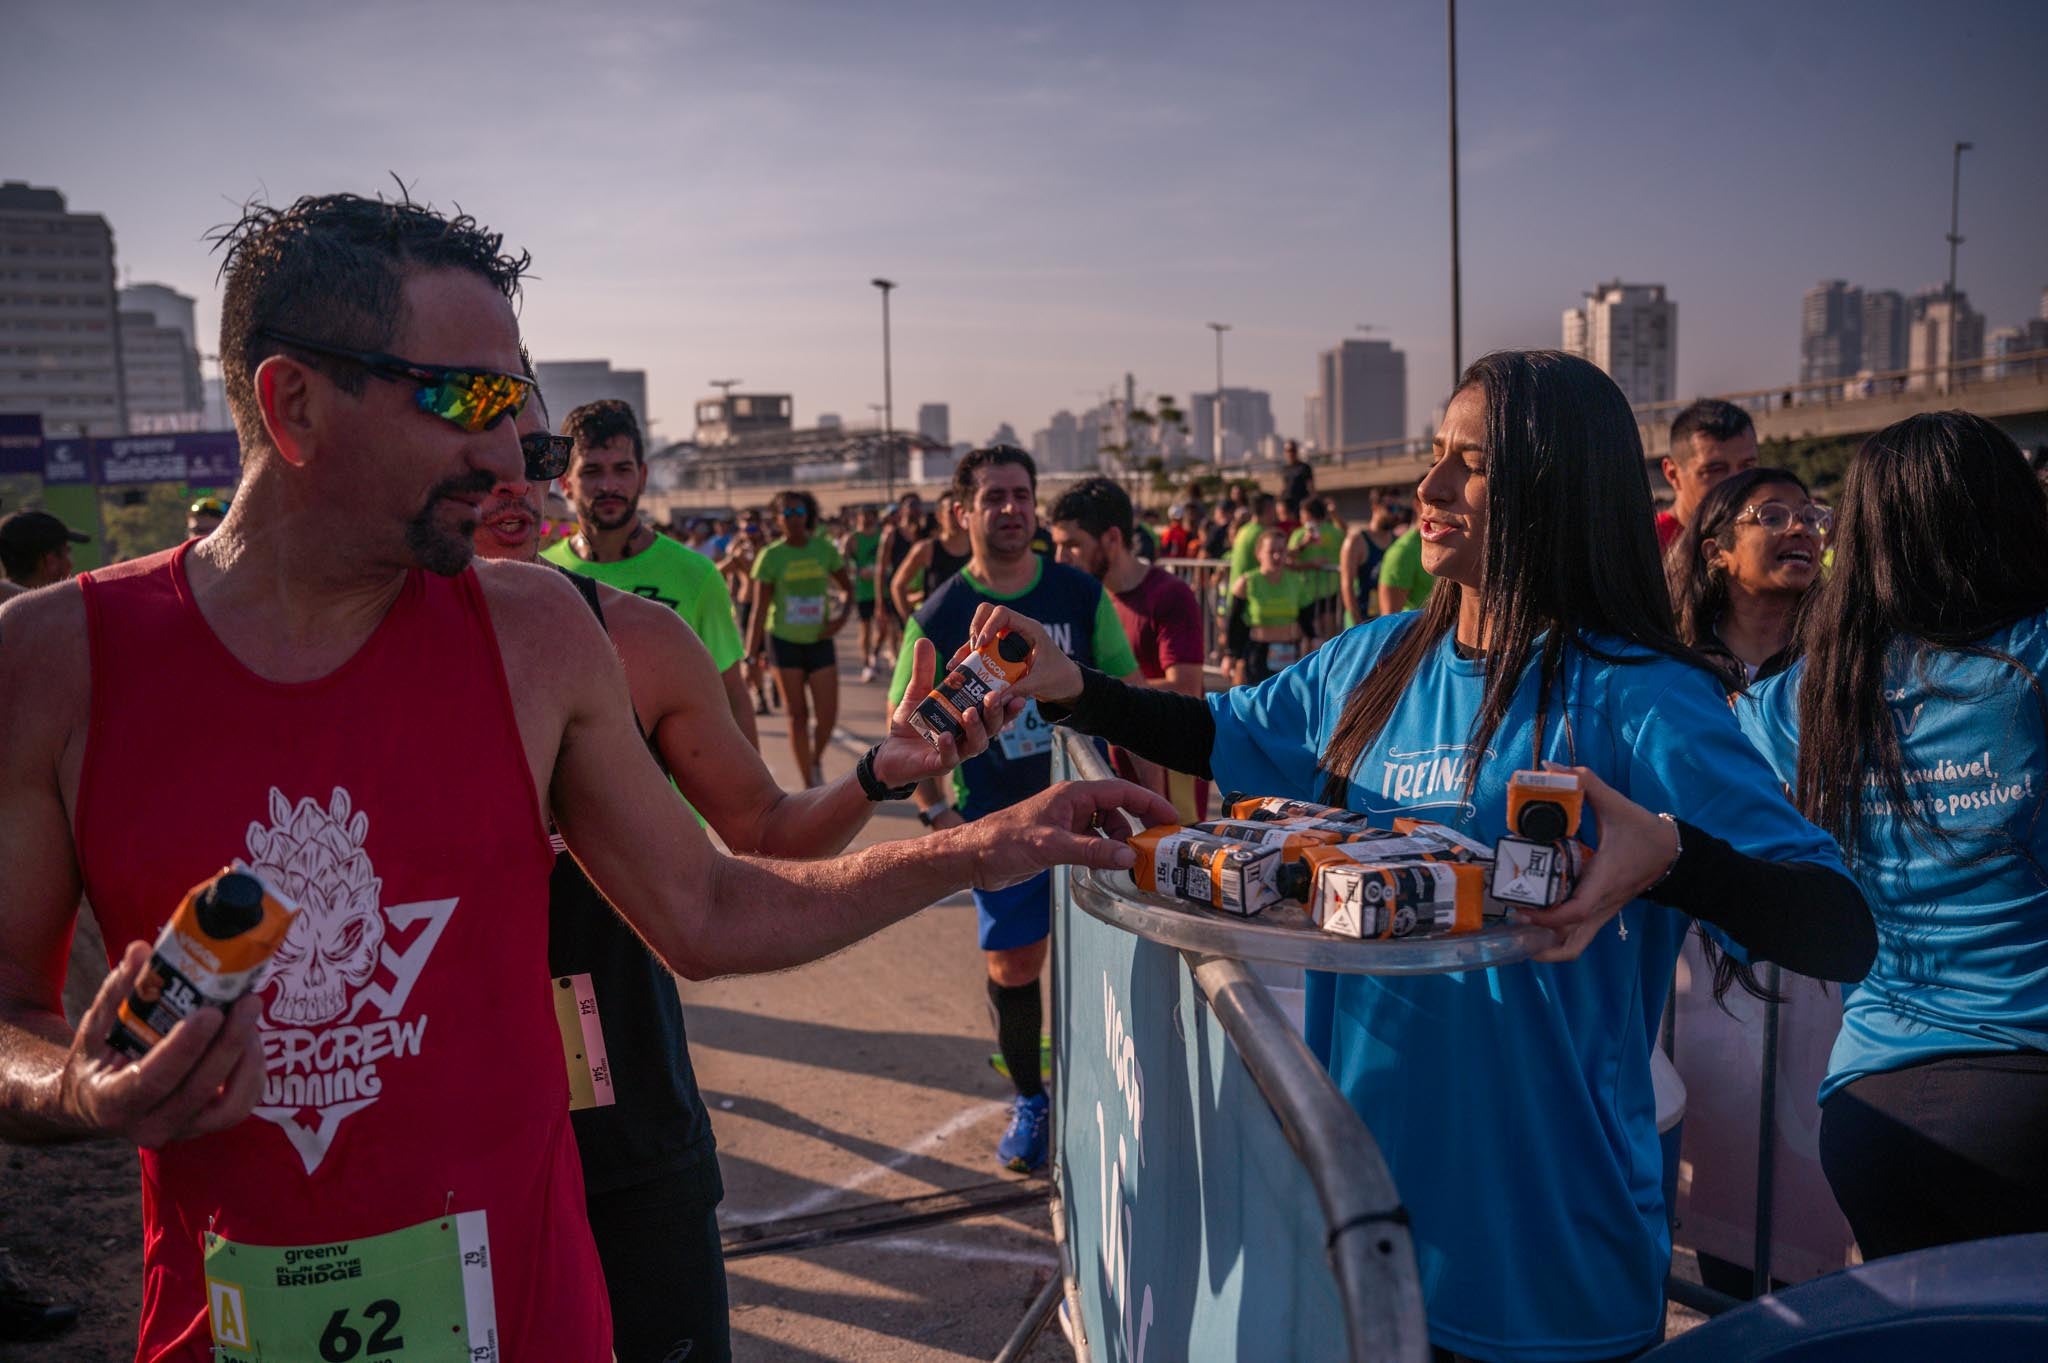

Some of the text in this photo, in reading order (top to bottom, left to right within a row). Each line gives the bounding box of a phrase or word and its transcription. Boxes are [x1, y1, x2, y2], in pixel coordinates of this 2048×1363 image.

[981, 654, 1007, 681] VIGOR
[1903, 751, 1999, 786] saudável,
[1949, 774, 2035, 817] possível
[579, 999, 590, 1016] 544
[259, 1014, 428, 1073] ERCREW
[592, 1064, 603, 1083] 544
[1103, 969, 1146, 1169] VIGOR
[262, 1064, 382, 1106] UNNING
[284, 1244, 349, 1266] greenv
[335, 1257, 361, 1268] THE
[464, 1250, 480, 1268] 62
[277, 1265, 363, 1287] BRIDGE
[219, 1290, 241, 1341] A
[318, 1298, 405, 1363] 62
[473, 1345, 489, 1363] 62
